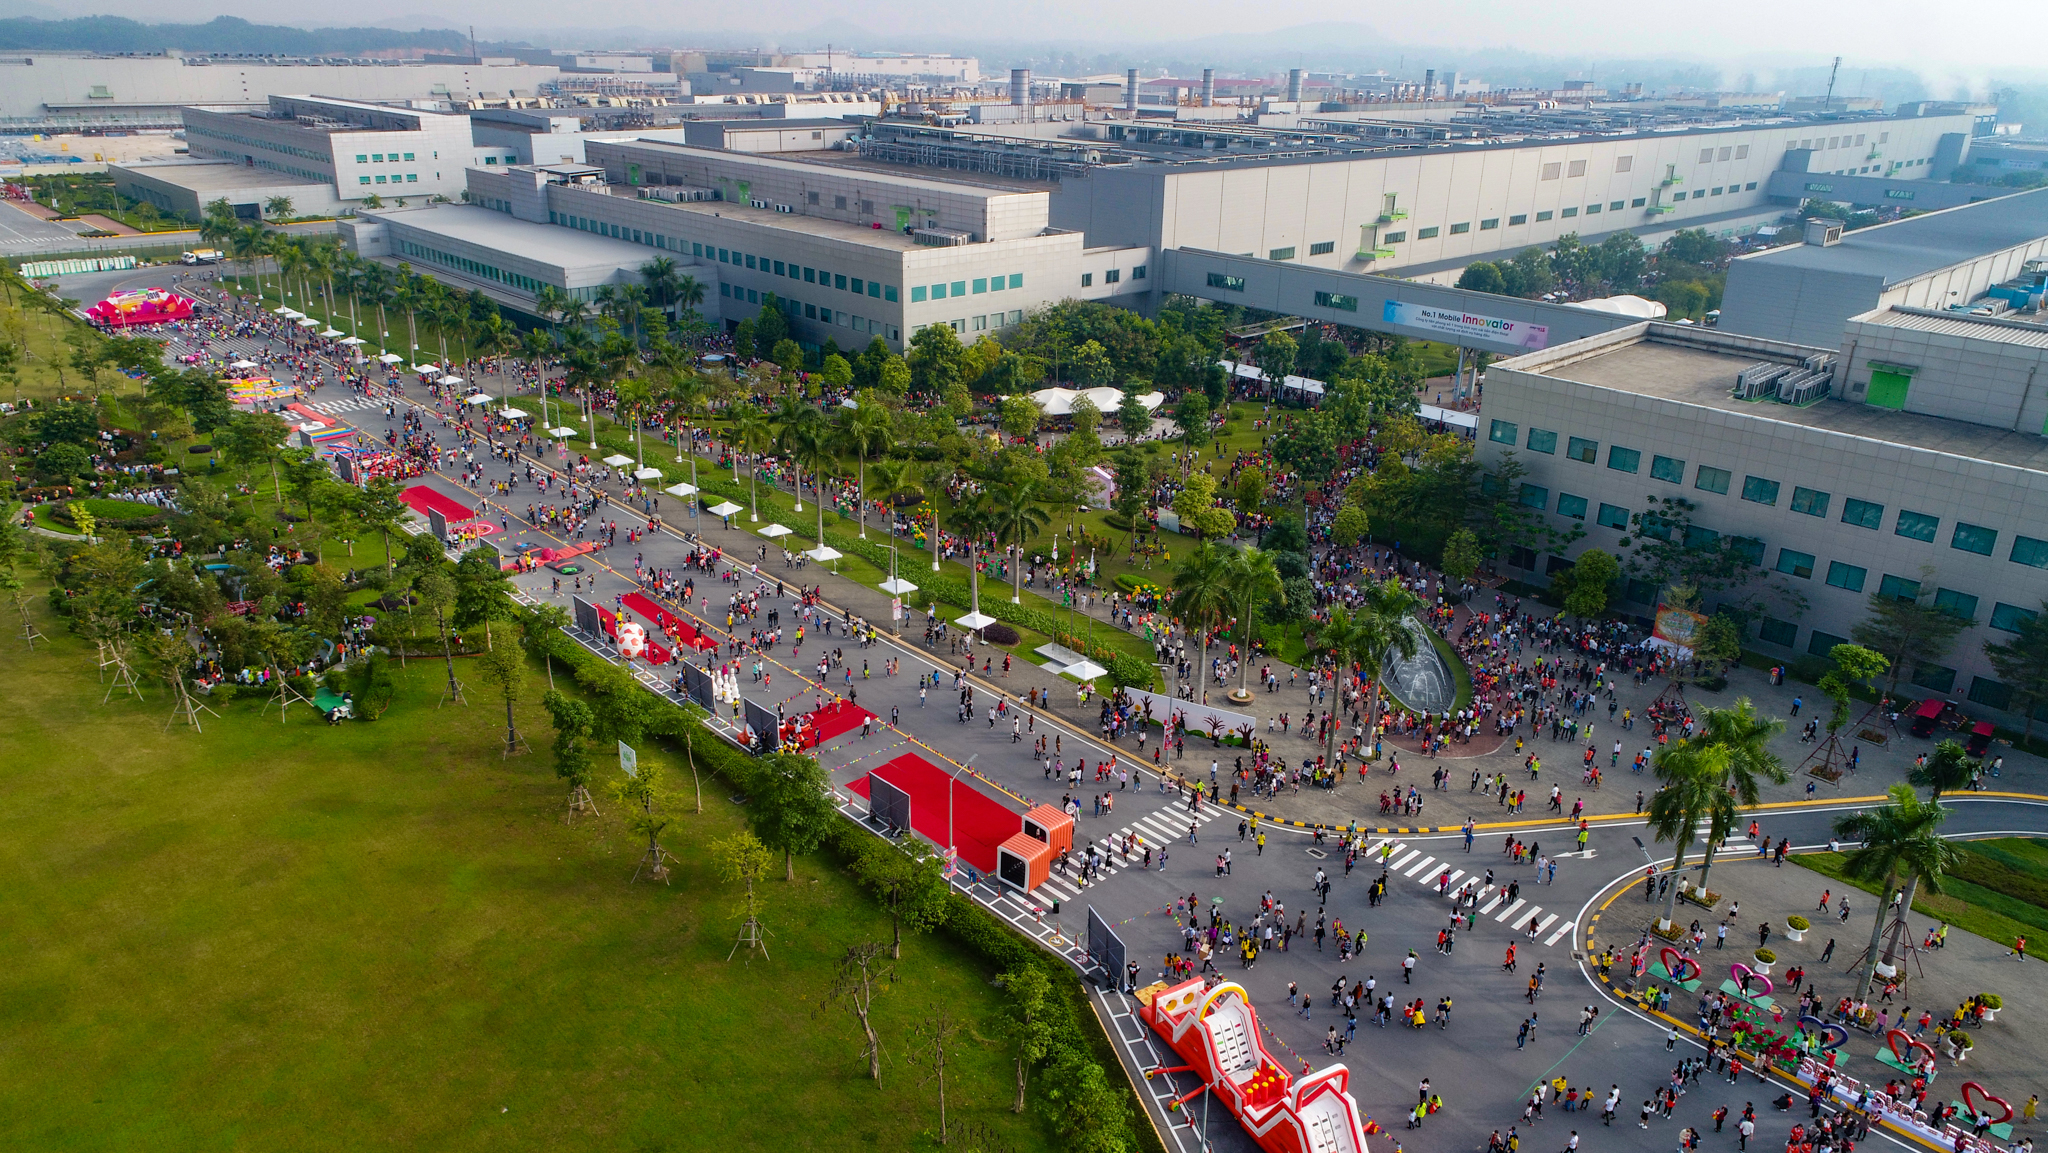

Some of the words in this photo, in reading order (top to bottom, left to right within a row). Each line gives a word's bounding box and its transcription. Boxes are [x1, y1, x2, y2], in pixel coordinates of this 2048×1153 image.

[1422, 310, 1436, 318] No.1
[1438, 313, 1461, 322] Mobile
[1462, 313, 1515, 331] Innovator
